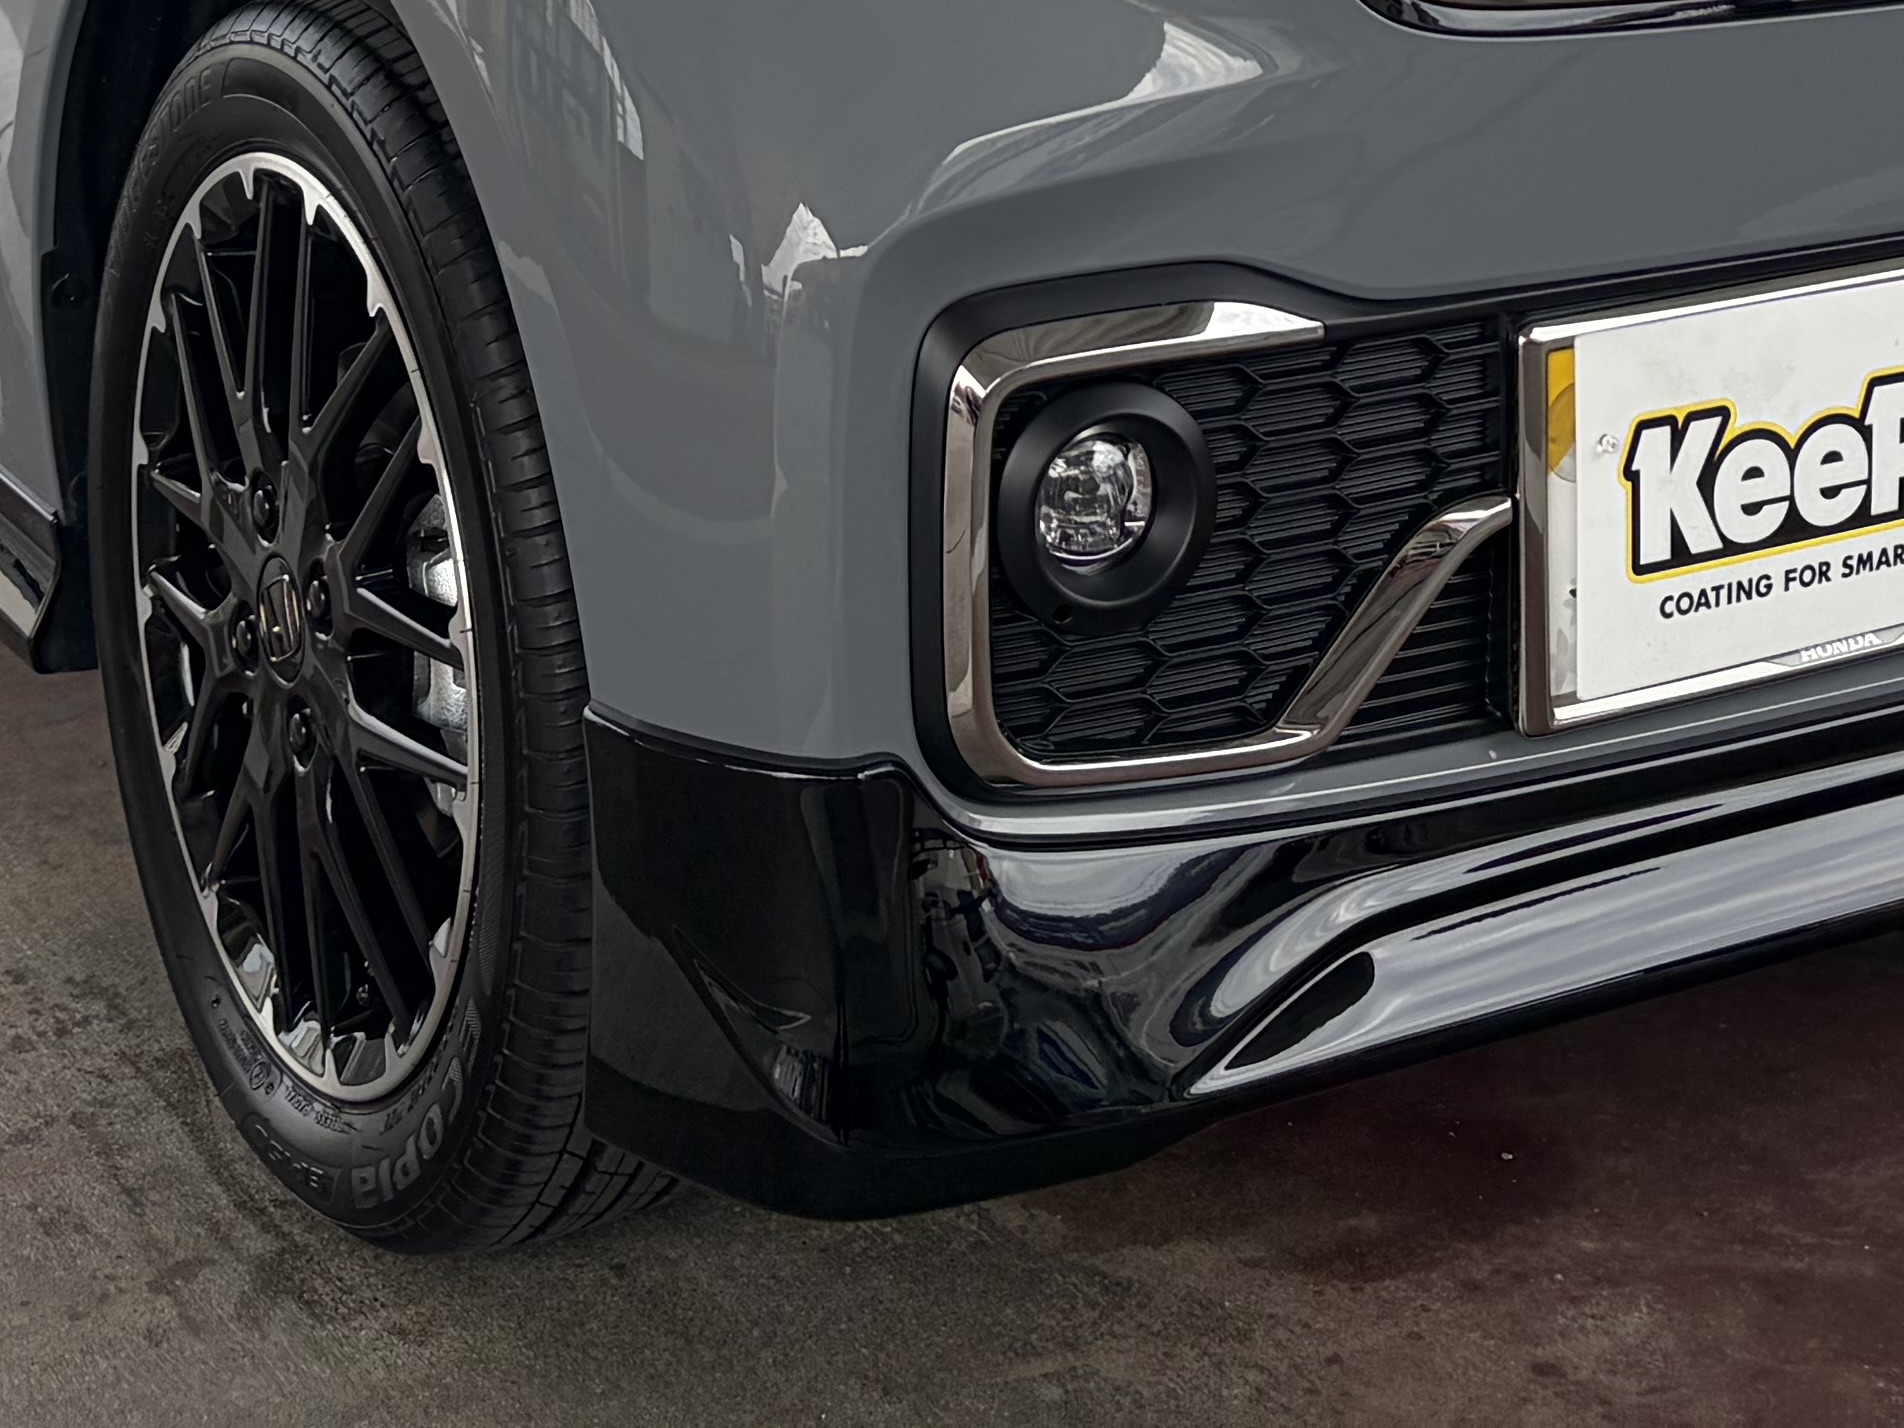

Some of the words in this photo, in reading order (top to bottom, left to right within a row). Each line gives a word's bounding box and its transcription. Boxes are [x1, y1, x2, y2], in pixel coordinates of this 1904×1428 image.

[1658, 573, 1774, 620] COATING
[1783, 561, 1832, 594] FOR
[1800, 632, 1883, 663] HONDA
